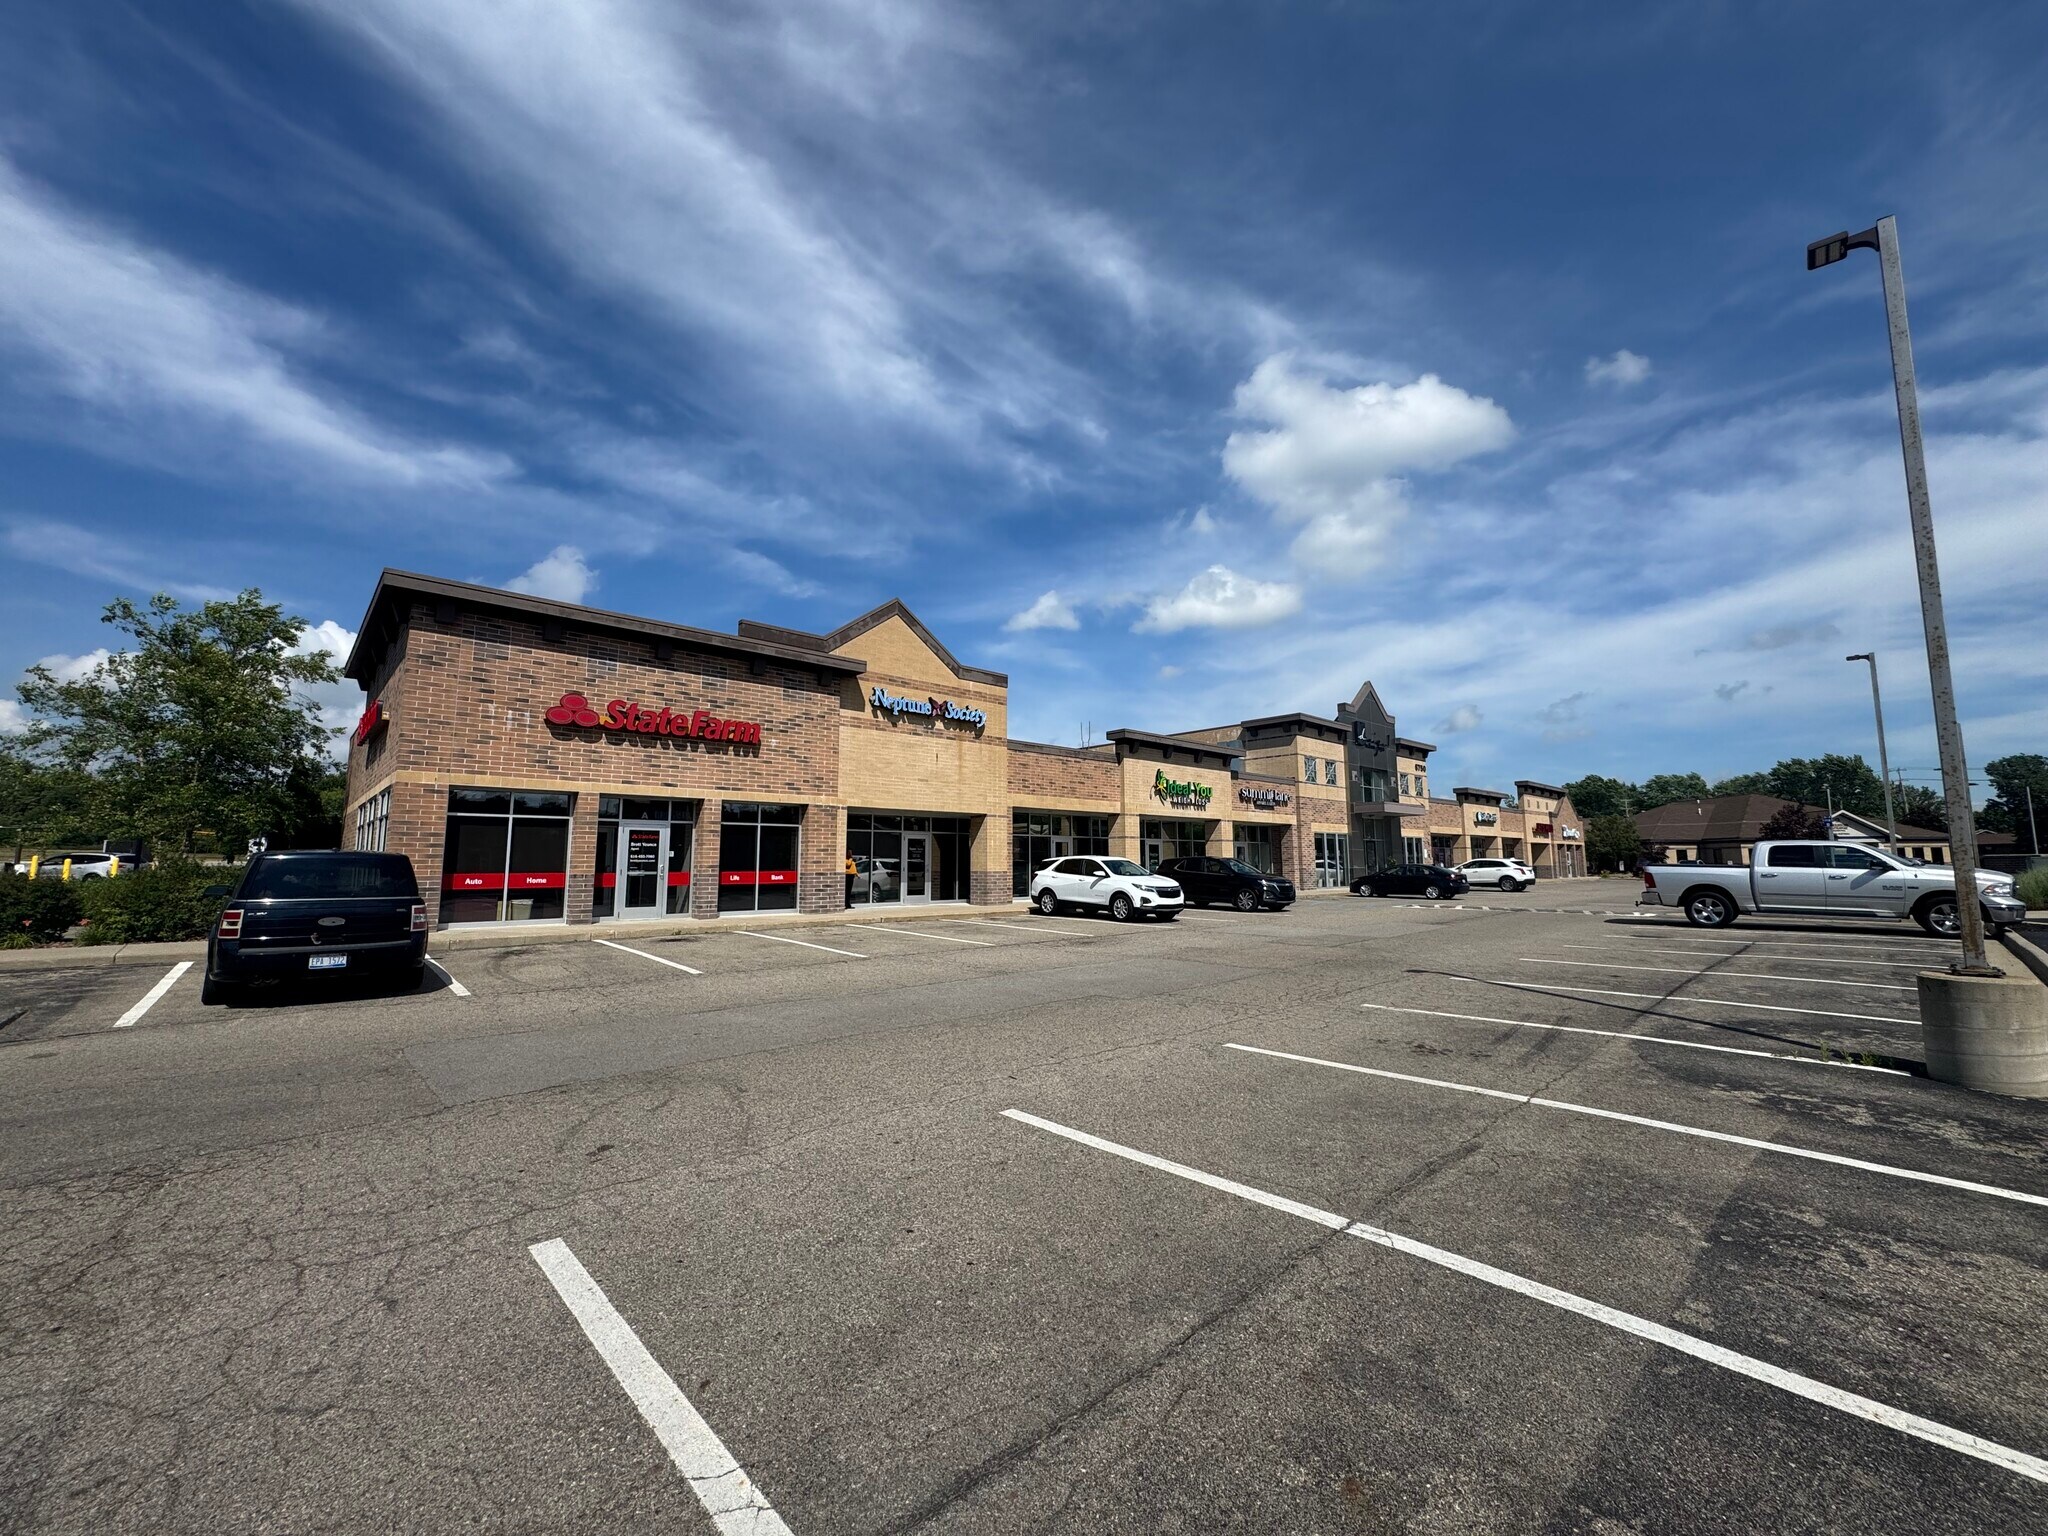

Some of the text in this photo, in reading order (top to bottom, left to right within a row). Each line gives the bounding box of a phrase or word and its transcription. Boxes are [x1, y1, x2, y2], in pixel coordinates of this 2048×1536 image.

[869, 687, 987, 727] Neptune Society
[604, 699, 761, 744] StateFarm
[1167, 780, 1214, 798] Ideal You
[1195, 797, 1209, 806] LOSS
[465, 877, 483, 885] Auto
